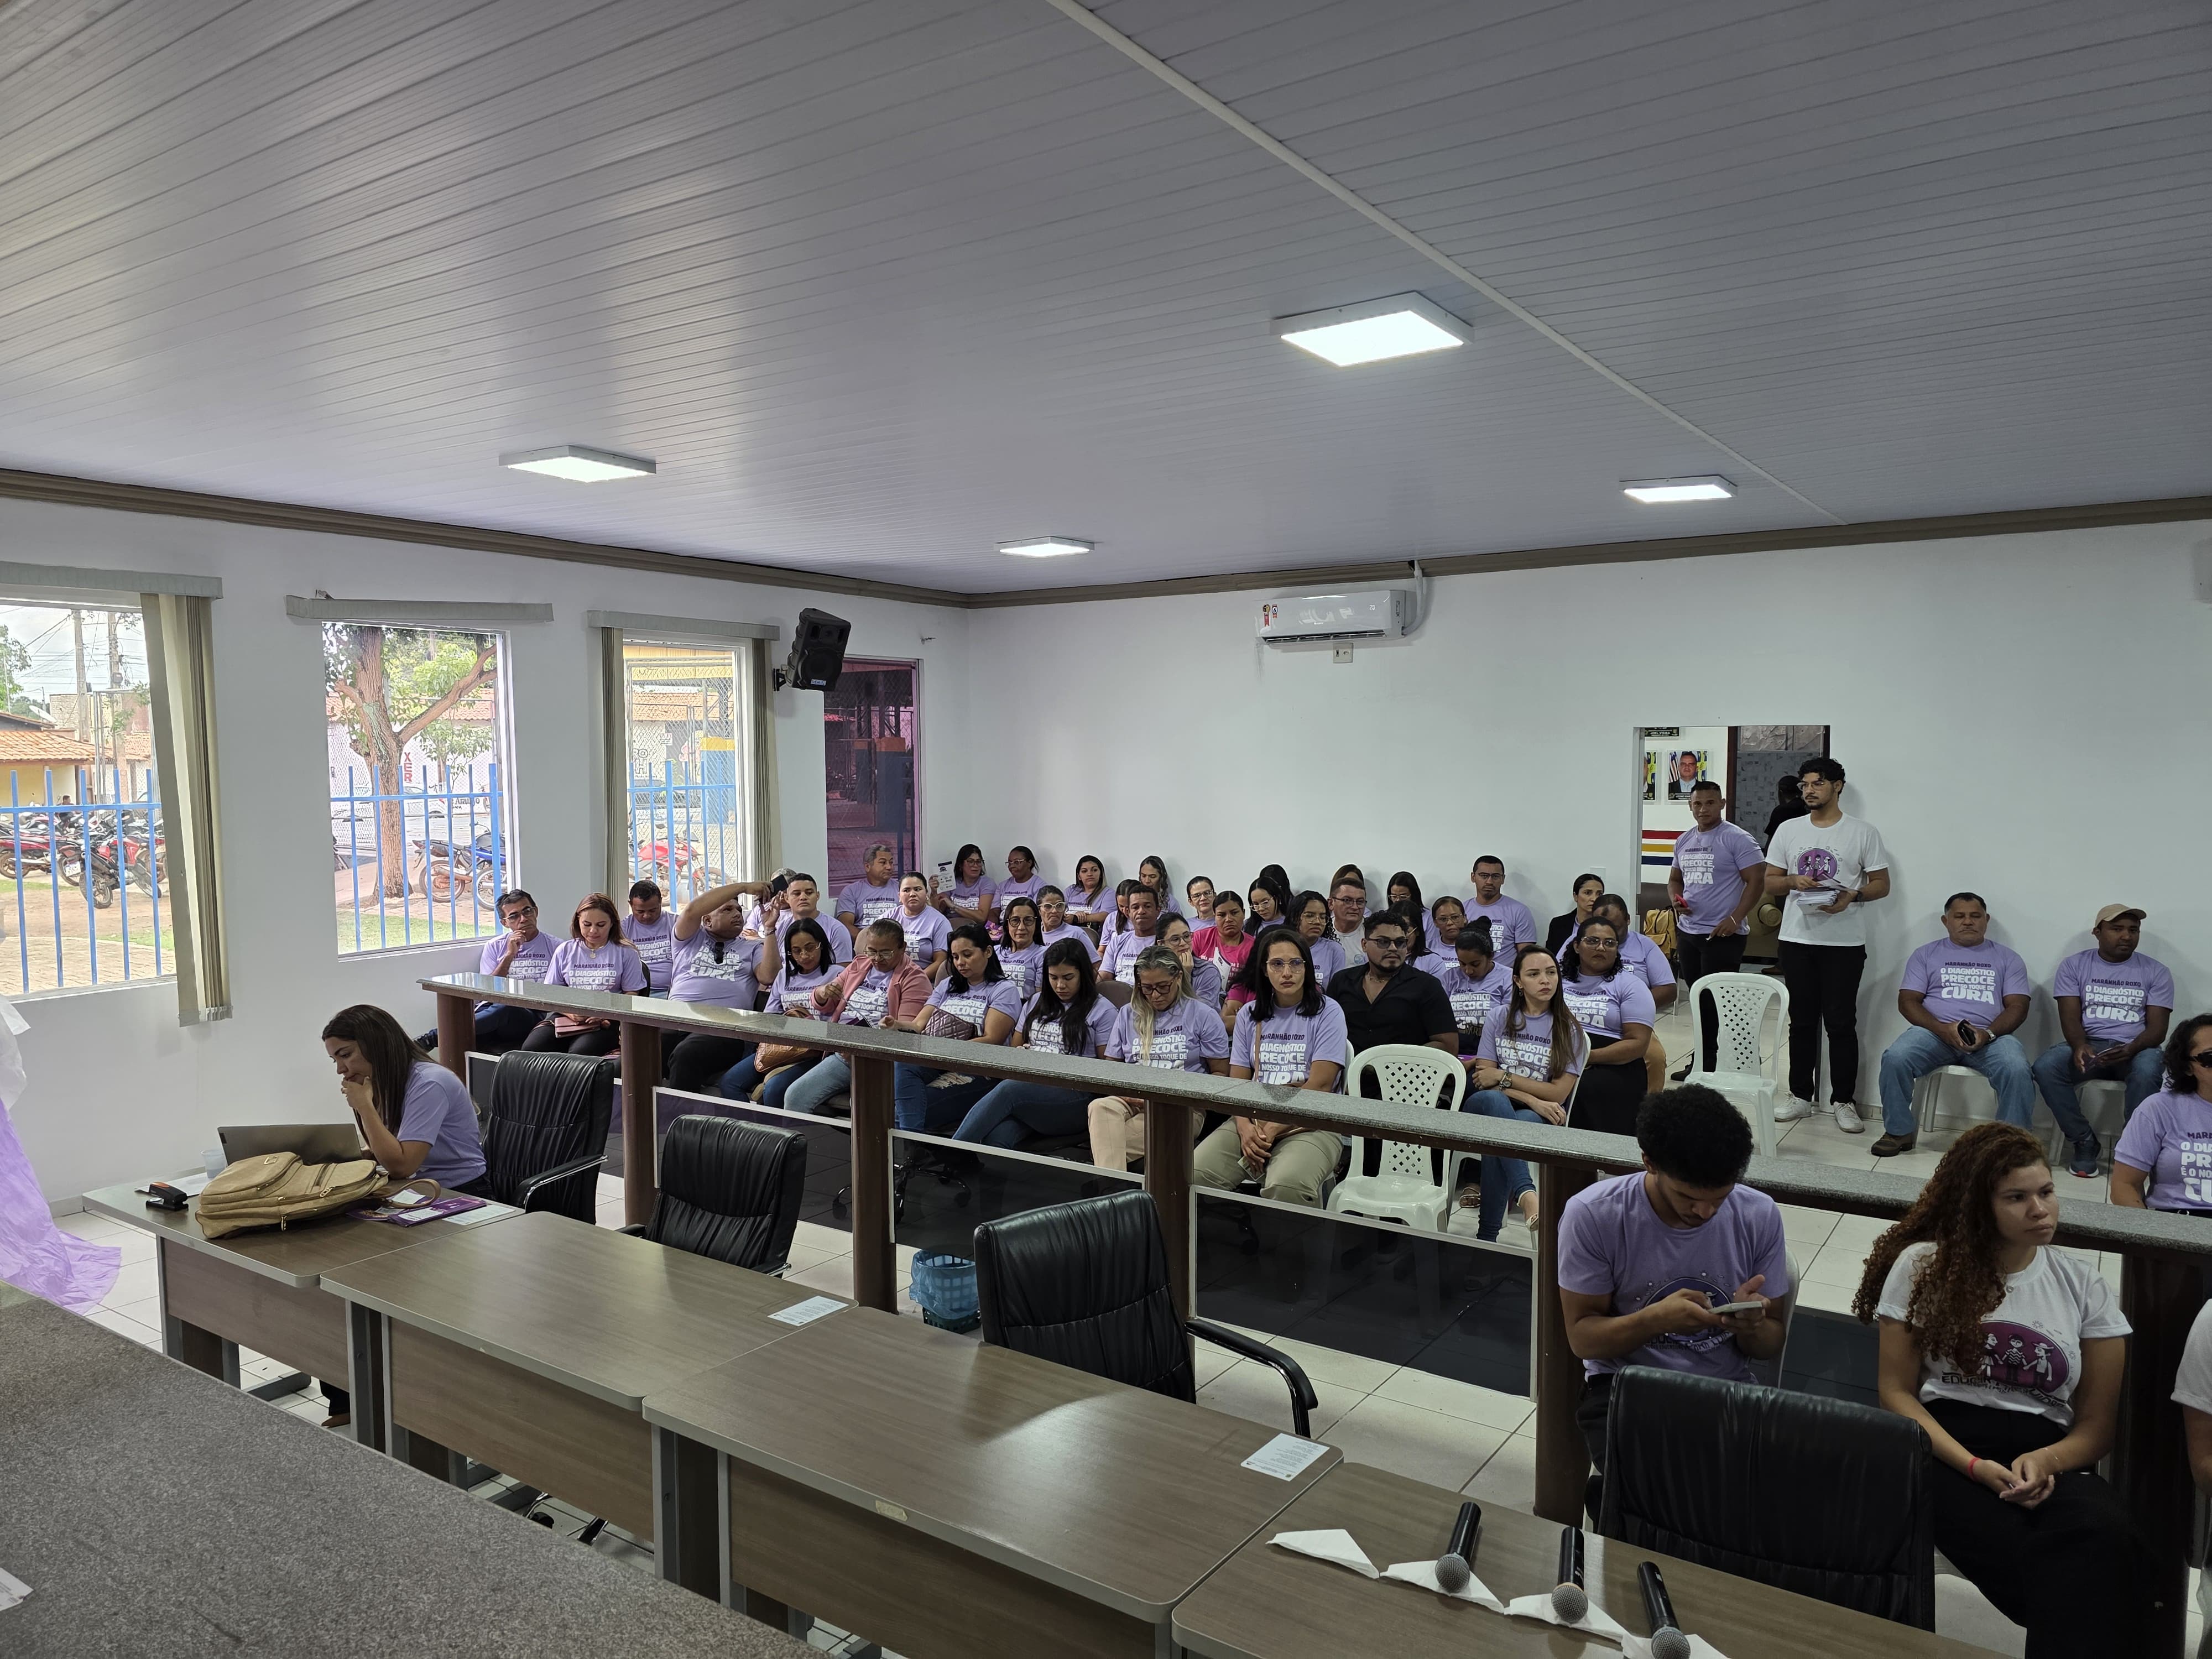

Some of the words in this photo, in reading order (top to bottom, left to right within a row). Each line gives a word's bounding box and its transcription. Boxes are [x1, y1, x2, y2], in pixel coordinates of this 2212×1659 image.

[639, 946, 671, 957] RECOCE
[1948, 967, 1995, 977] DIAGNÓSTICO
[569, 977, 615, 985] PRECOCE
[784, 992, 811, 1002] DIAGNÓST
[1450, 992, 1491, 1001] DIAGNÓSTICO
[1941, 986, 1994, 1005] CURA
[2093, 985, 2145, 997] DIAGNÓSTICO
[1451, 1001, 1491, 1011] RECOCE
[1566, 1000, 1609, 1011] RECOCE,
[2086, 1004, 2140, 1022] CURA
[1575, 1013, 1605, 1028] RA
[1029, 1030, 1064, 1045] RECOC
[1140, 1034, 1186, 1045] GNÓSTICO
[1501, 1031, 1533, 1041] ANHÃO
[1535, 1036, 1551, 1045] ROXO
[1132, 1042, 1188, 1055] PECOCE,
[1495, 1037, 1500, 1046] O
[1501, 1039, 1552, 1057] DIAGNÓSTICO
[1259, 1052, 1307, 1065] RECOCE,
[1258, 1071, 1305, 1084] URA
[2180, 1141, 2190, 1151] O
[2181, 1152, 2212, 1168] PR
[2180, 1166, 2187, 1176] É
[2189, 1168, 2196, 1177] O
[1942, 1373, 1992, 1385] EDUCR
